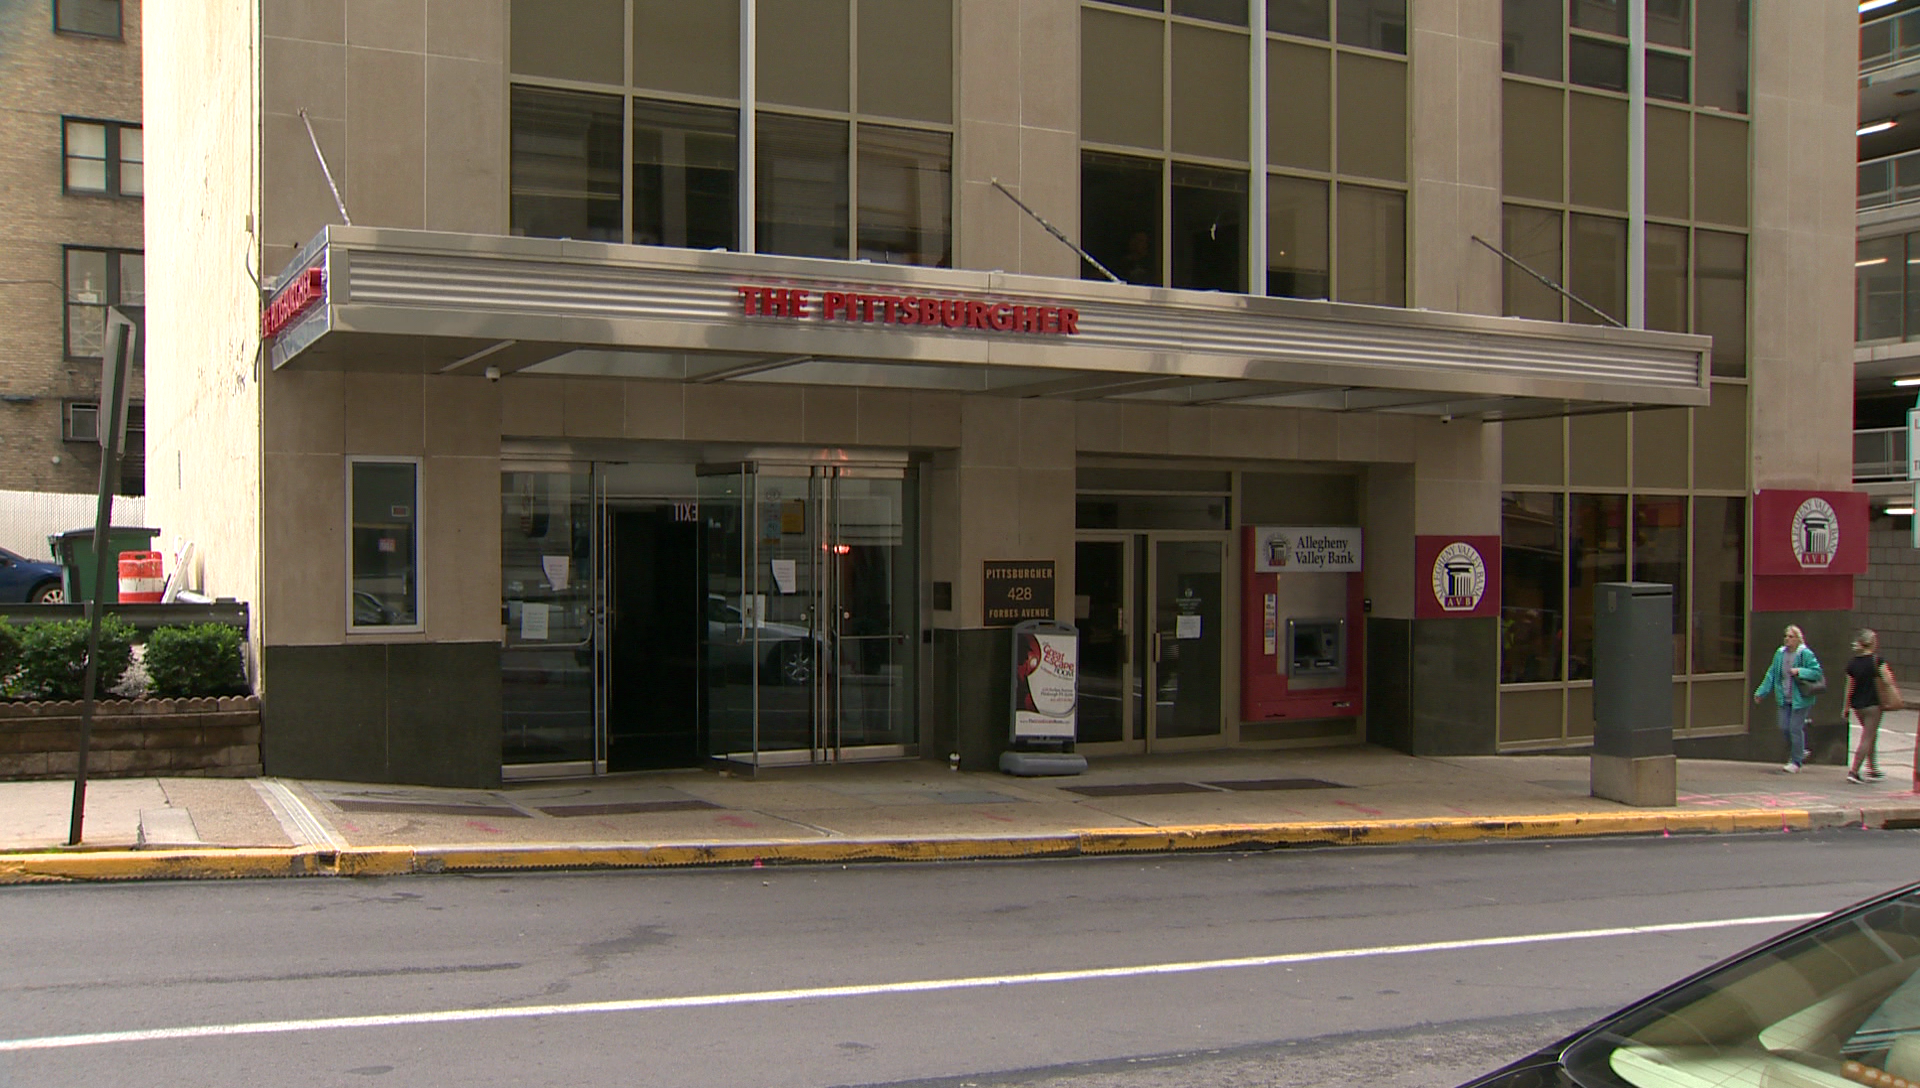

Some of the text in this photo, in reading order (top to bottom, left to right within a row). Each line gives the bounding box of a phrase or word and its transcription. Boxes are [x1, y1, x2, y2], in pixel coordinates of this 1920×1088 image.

[738, 286, 1080, 334] THE PITTSBURGHER
[1297, 536, 1348, 553] Allegheny
[1295, 551, 1354, 568] Valley Bank
[986, 568, 1053, 579] PITTSBURGHER
[1434, 545, 1455, 599] ALLEGHENY
[1007, 587, 1032, 601] 428
[989, 608, 1050, 618] FORBES AVENUE
[1043, 644, 1065, 661] Great
[1043, 652, 1074, 671] Escape
